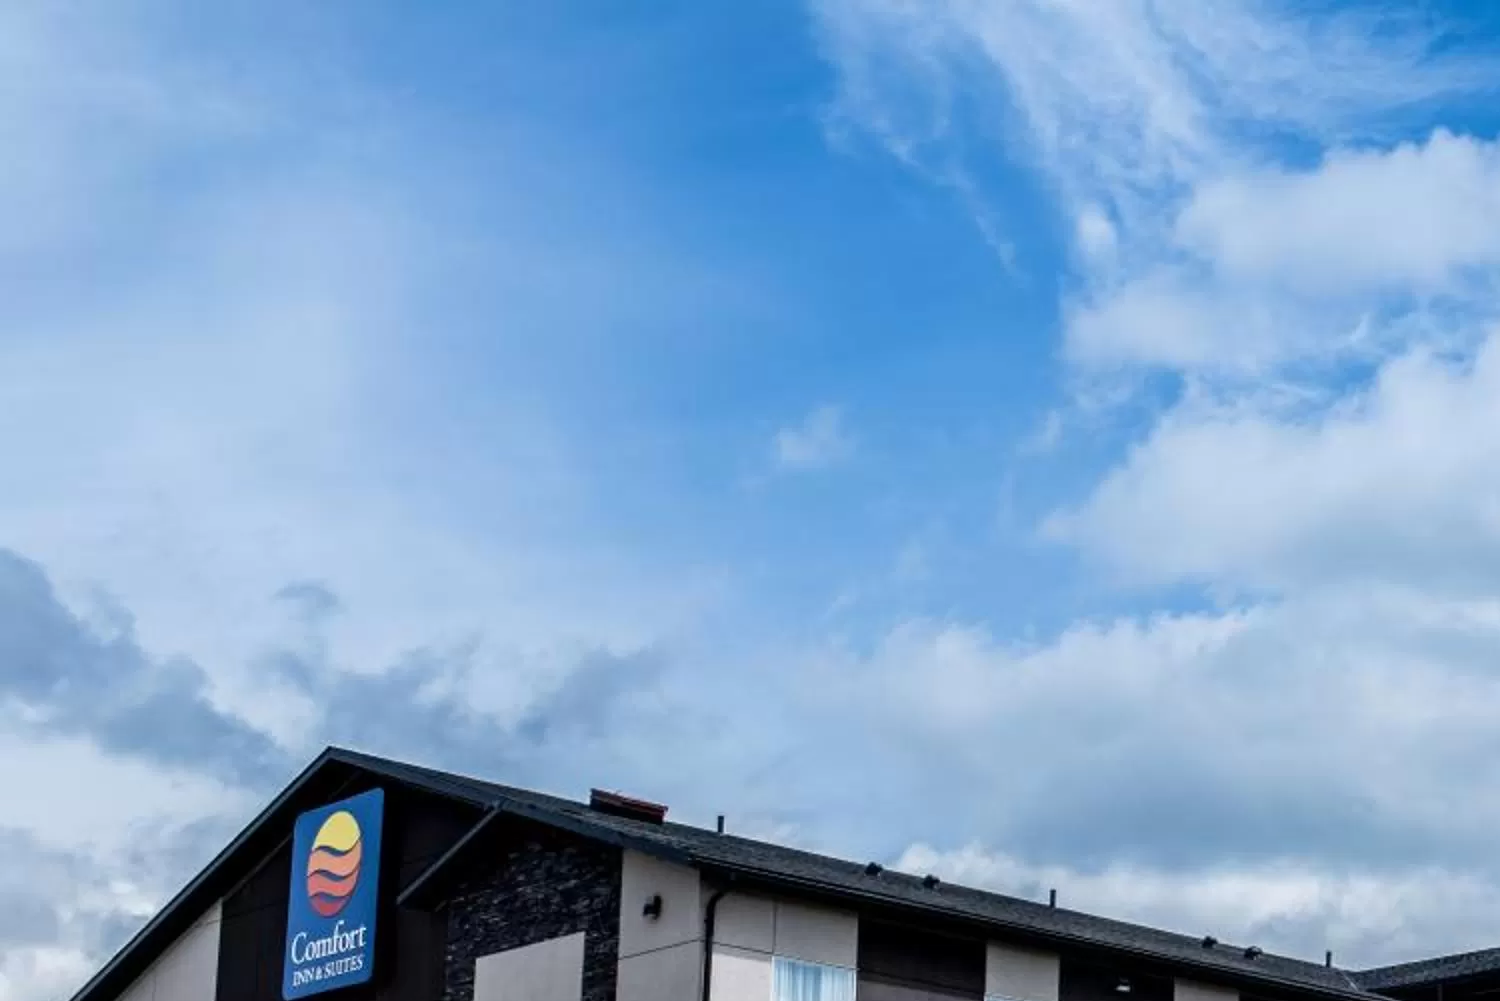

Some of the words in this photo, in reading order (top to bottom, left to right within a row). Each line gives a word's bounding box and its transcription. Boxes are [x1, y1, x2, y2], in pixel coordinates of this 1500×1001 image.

[291, 919, 367, 965] Comfort
[292, 966, 315, 987] INN
[324, 954, 364, 979] SUITES
